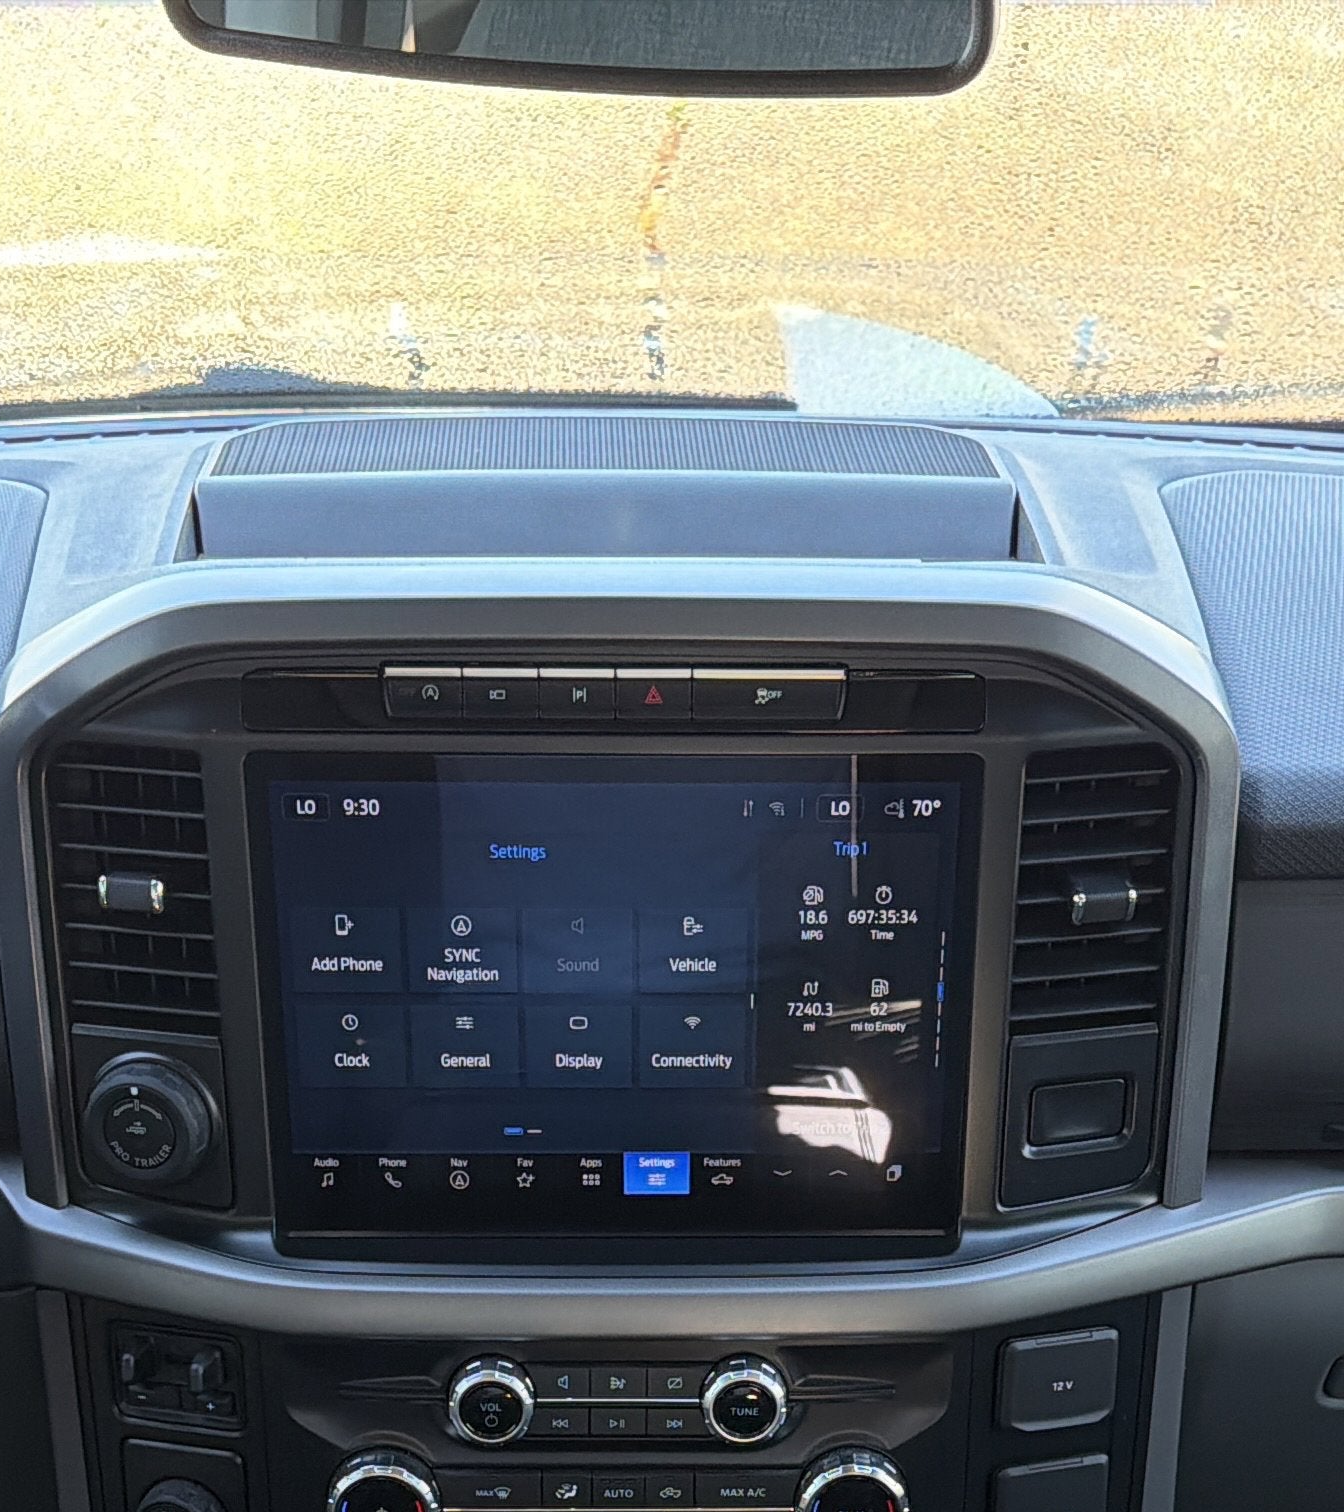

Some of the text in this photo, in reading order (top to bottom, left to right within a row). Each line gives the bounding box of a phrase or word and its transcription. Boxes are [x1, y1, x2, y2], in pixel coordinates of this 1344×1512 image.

[768, 690, 783, 699] OFF
[296, 799, 316, 815] LO
[343, 799, 380, 816] 9:30
[830, 801, 851, 816] LO
[912, 800, 942, 817] 70°
[489, 844, 547, 862] Settings
[833, 841, 868, 857] Trip 1
[798, 910, 828, 924] 18.6
[848, 909, 918, 924] 697:35:34
[801, 930, 824, 940] MPG
[870, 929, 895, 940] Time
[444, 948, 481, 963] SYNC
[311, 957, 384, 972] Add Phone
[557, 958, 600, 972] Sound
[669, 957, 717, 973] Vehicle
[427, 967, 499, 984] Navigation
[787, 1002, 833, 1017] 7240.3
[870, 1002, 887, 1016] 62
[803, 1022, 815, 1032] mi
[850, 1022, 906, 1034] mi to Empty
[334, 1053, 371, 1068] Clock
[440, 1053, 491, 1068] General
[555, 1053, 604, 1070] Display
[651, 1053, 733, 1070] Connectivity
[793, 1120, 835, 1135] Switch
[110, 1140, 172, 1168] PRO TRAILER
[313, 1157, 340, 1168] Audio
[378, 1157, 407, 1168] Phone
[450, 1158, 468, 1168] Nav
[517, 1158, 534, 1168] Fav
[580, 1158, 603, 1170] Apps
[638, 1157, 676, 1169] Settings
[703, 1157, 742, 1168] Features
[1052, 1382, 1064, 1392] 12
[480, 1402, 502, 1413] VOL
[730, 1406, 759, 1417] TUNE
[475, 1489, 494, 1497] MAX
[604, 1488, 633, 1499] AUTO
[720, 1487, 766, 1498] MAX A/C
